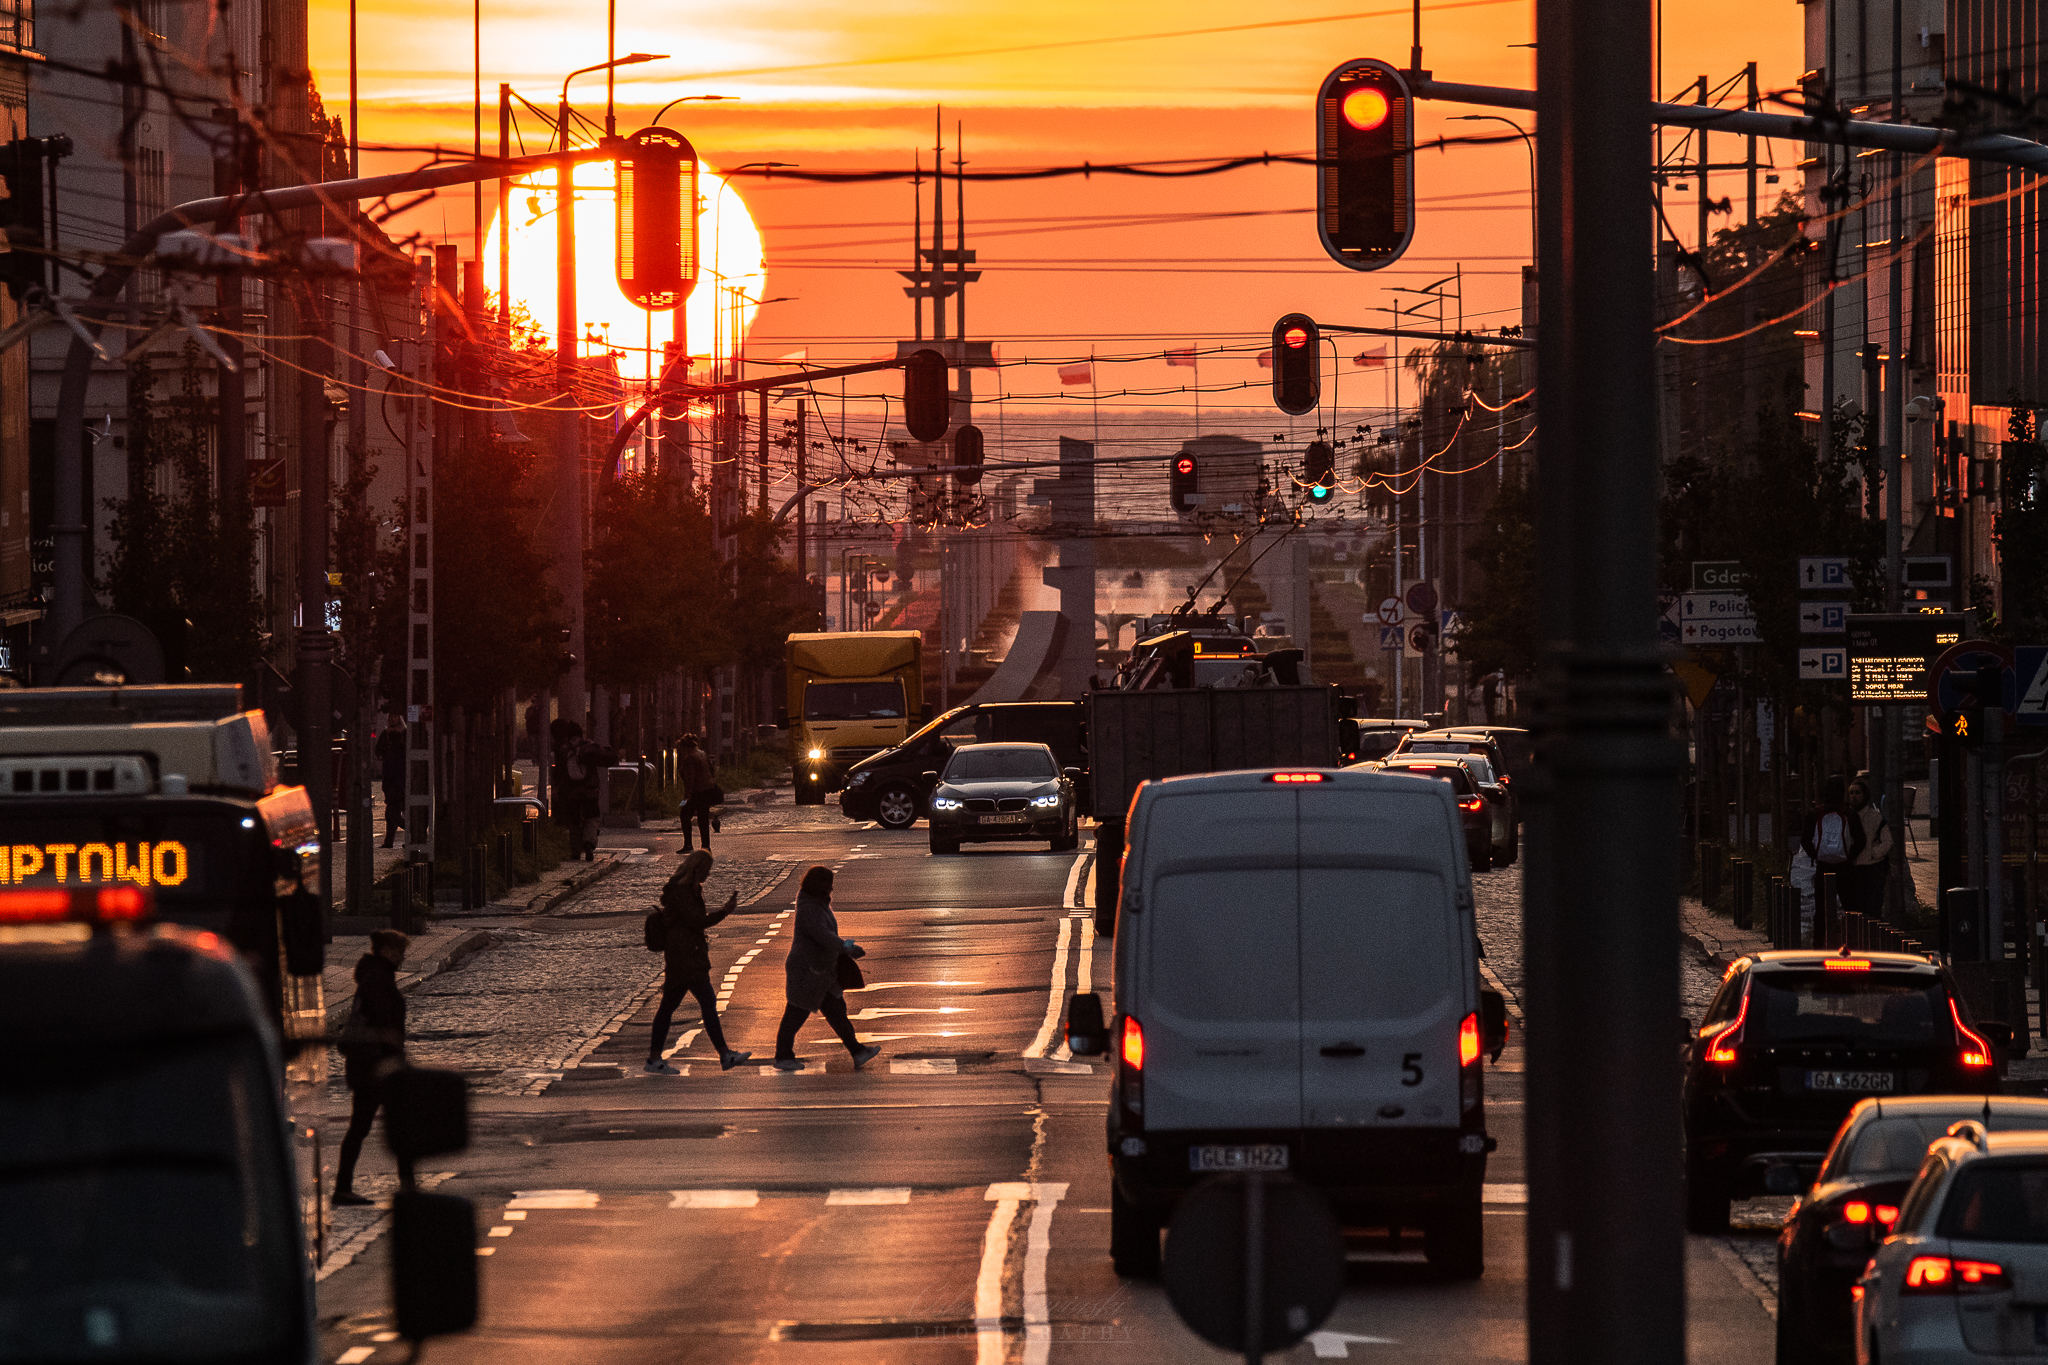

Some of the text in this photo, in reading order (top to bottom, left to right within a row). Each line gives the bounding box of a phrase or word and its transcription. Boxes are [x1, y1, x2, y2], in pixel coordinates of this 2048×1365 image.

[1709, 599, 1747, 613] Polic
[0, 841, 188, 886] PTOWO
[1402, 1053, 1424, 1087] 5
[1815, 1073, 1890, 1090] GA 562GR
